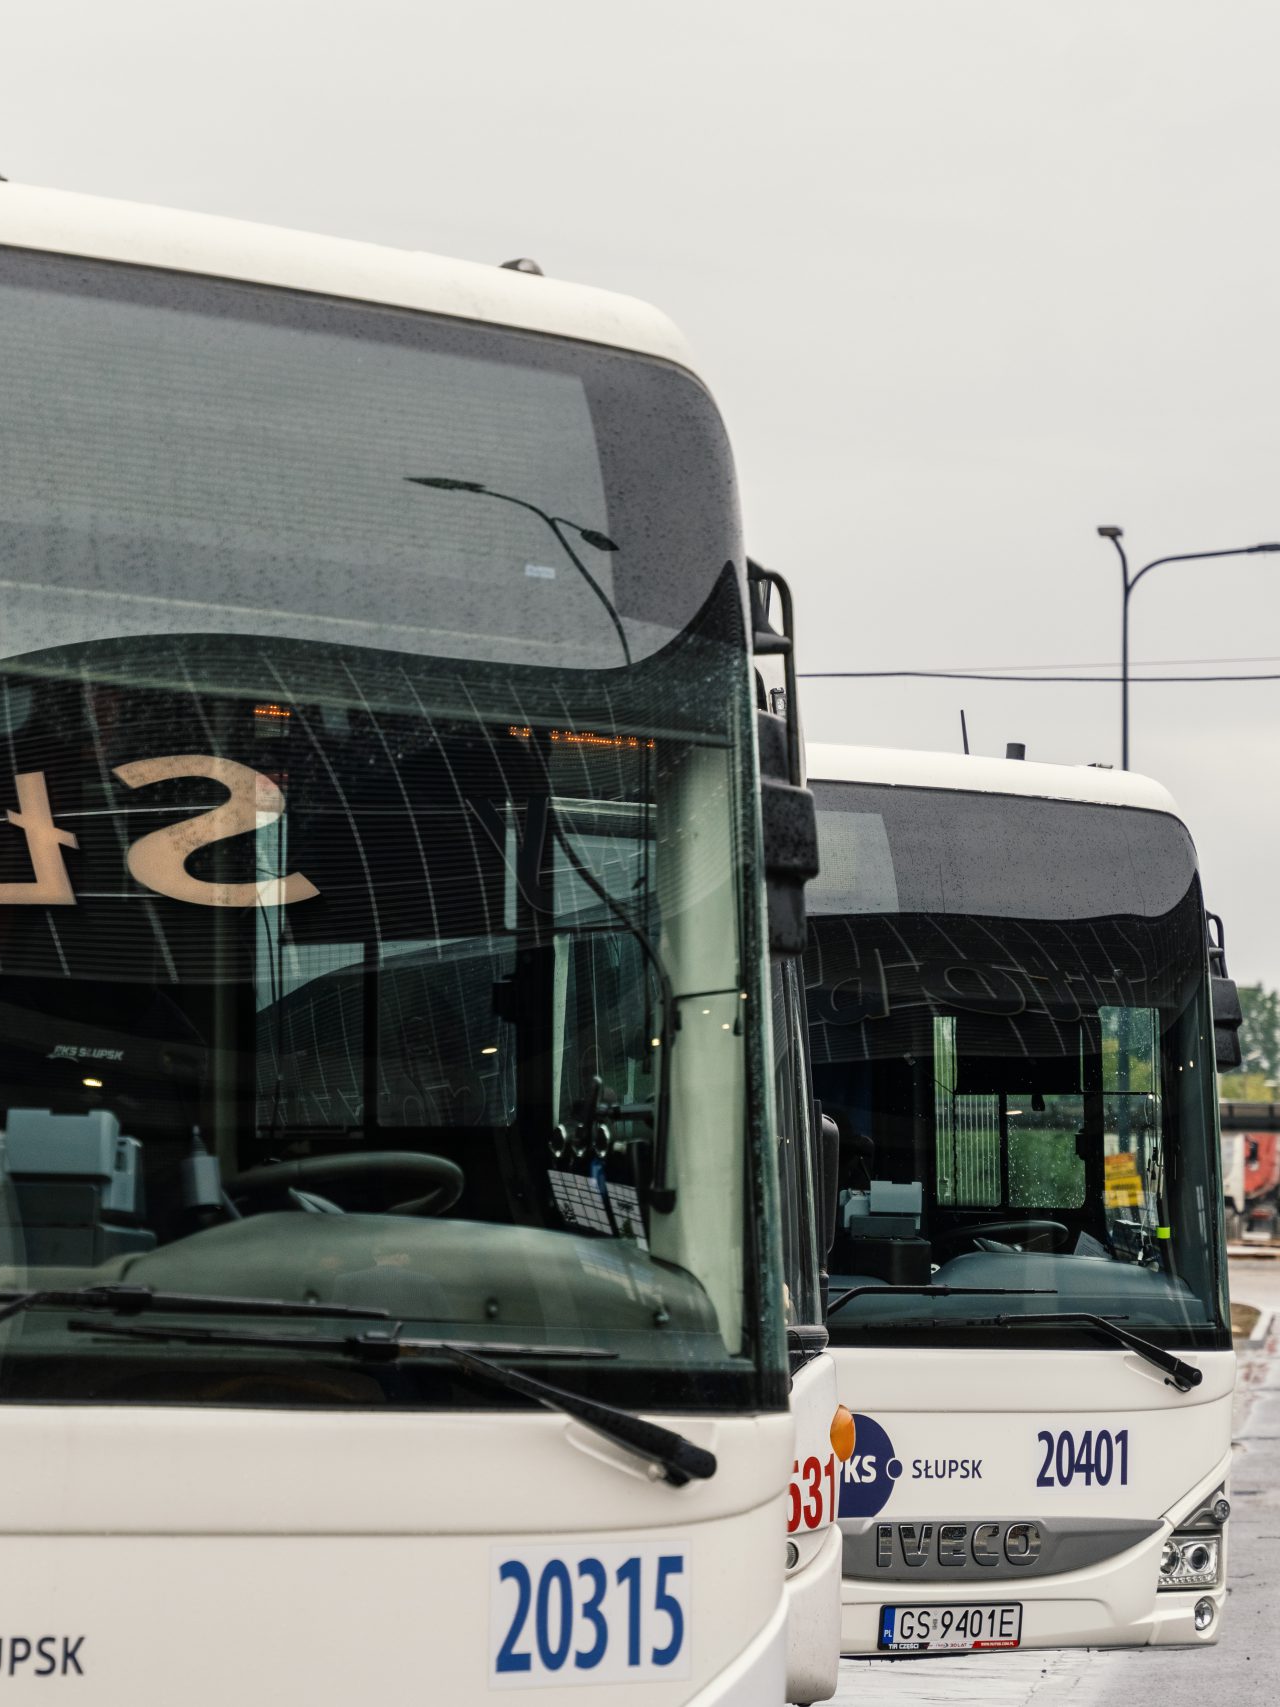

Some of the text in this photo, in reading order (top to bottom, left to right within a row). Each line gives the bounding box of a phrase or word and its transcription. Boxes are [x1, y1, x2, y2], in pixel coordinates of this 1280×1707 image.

[840, 1455, 983, 1484] KS SŁUPSK
[1036, 1429, 1128, 1487] 20401
[876, 1523, 1042, 1568] IVECO
[495, 1555, 685, 1674] 20315
[883, 1629, 893, 1638] PL
[900, 1608, 1015, 1640] GS 9401E
